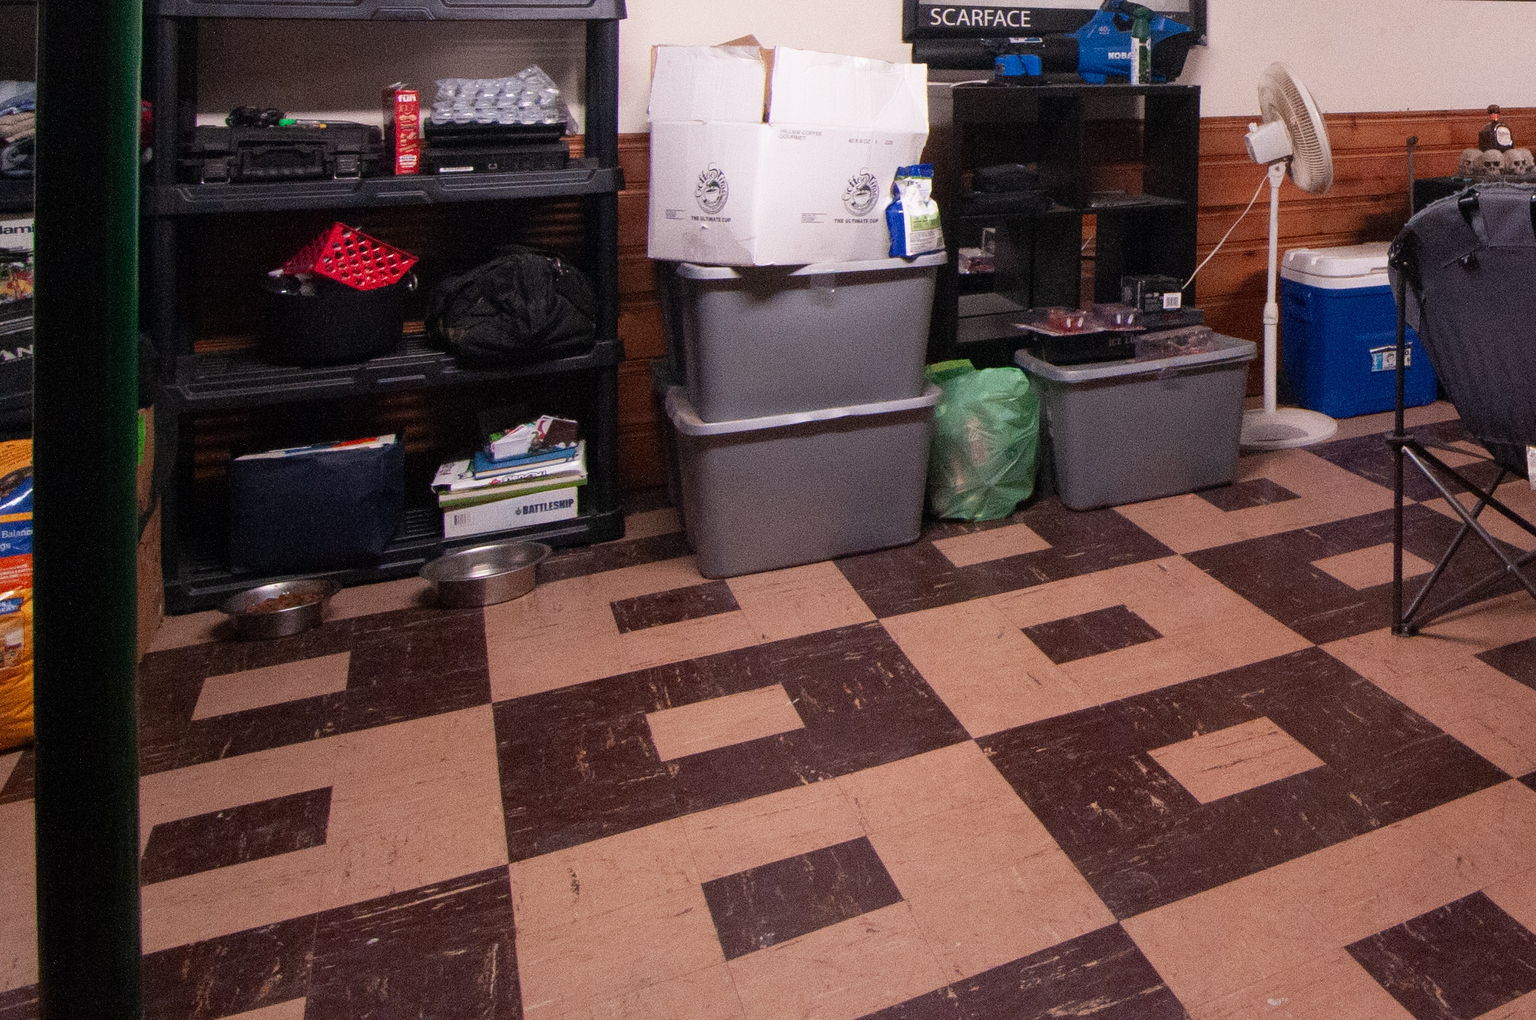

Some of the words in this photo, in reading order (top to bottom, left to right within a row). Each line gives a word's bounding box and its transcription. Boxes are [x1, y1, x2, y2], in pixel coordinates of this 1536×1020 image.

[930, 8, 1031, 28] SCARFACE
[1108, 52, 1132, 60] KOBA
[522, 498, 574, 515] BATTLESHIP
